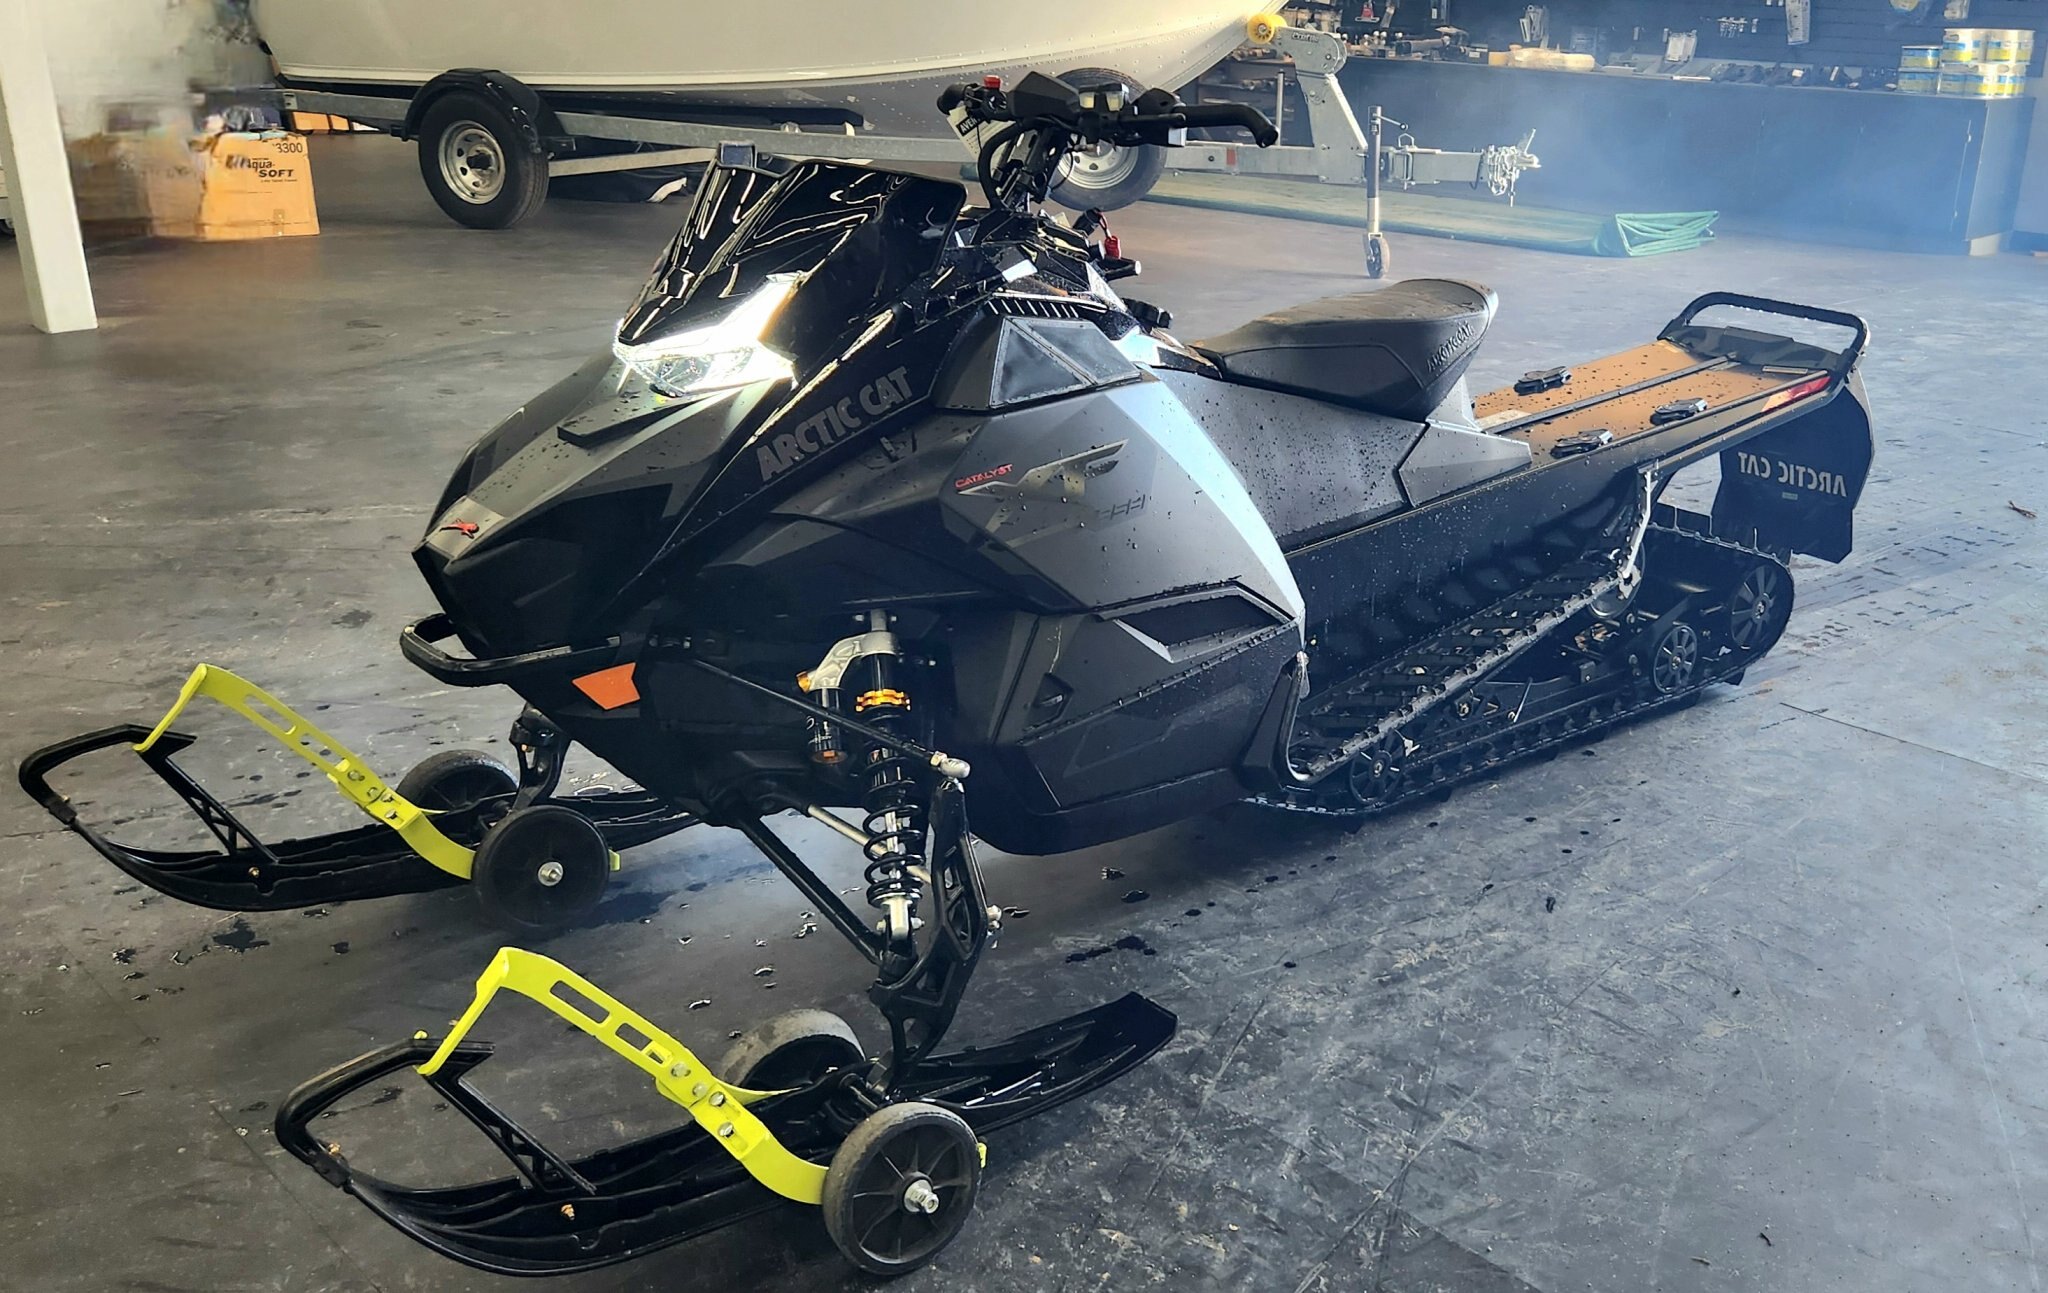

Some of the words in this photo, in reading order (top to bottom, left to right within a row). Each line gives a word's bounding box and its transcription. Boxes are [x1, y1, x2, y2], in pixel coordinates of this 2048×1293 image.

[258, 169, 295, 178] SOFT
[756, 396, 862, 482] ARCTIC
[859, 365, 913, 416] CAT
[955, 463, 1014, 488] CATALYST
